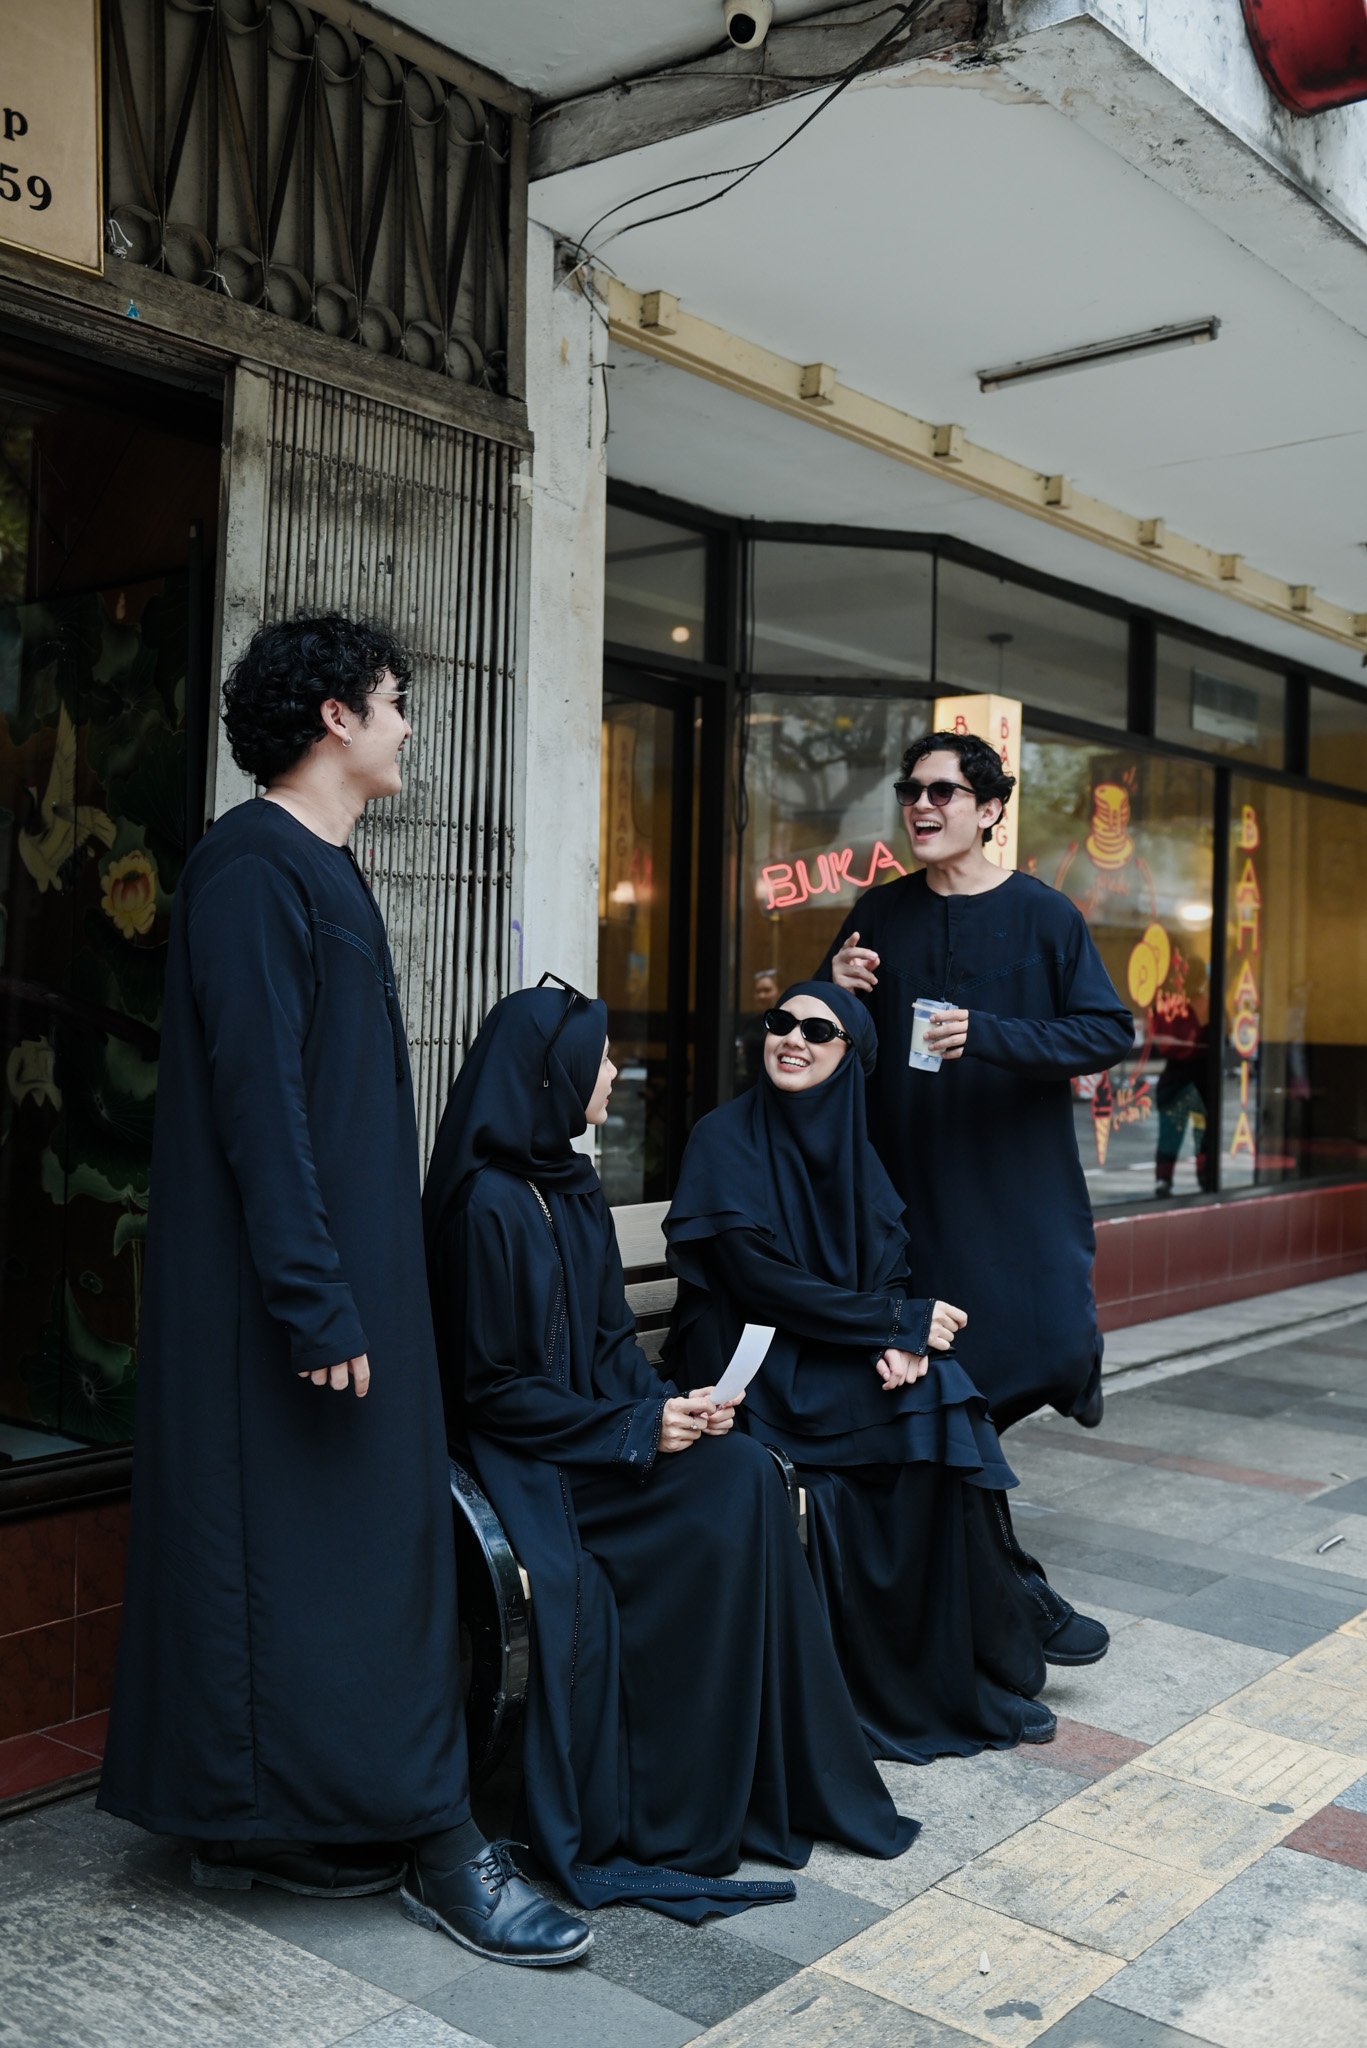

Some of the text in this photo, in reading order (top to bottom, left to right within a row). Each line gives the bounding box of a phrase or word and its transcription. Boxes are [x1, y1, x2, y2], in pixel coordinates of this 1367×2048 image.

[3, 107, 29, 141] p
[0, 162, 52, 211] 59
[761, 840, 908, 910] BUKA
[1229, 804, 1262, 1159] BAHAGIA
